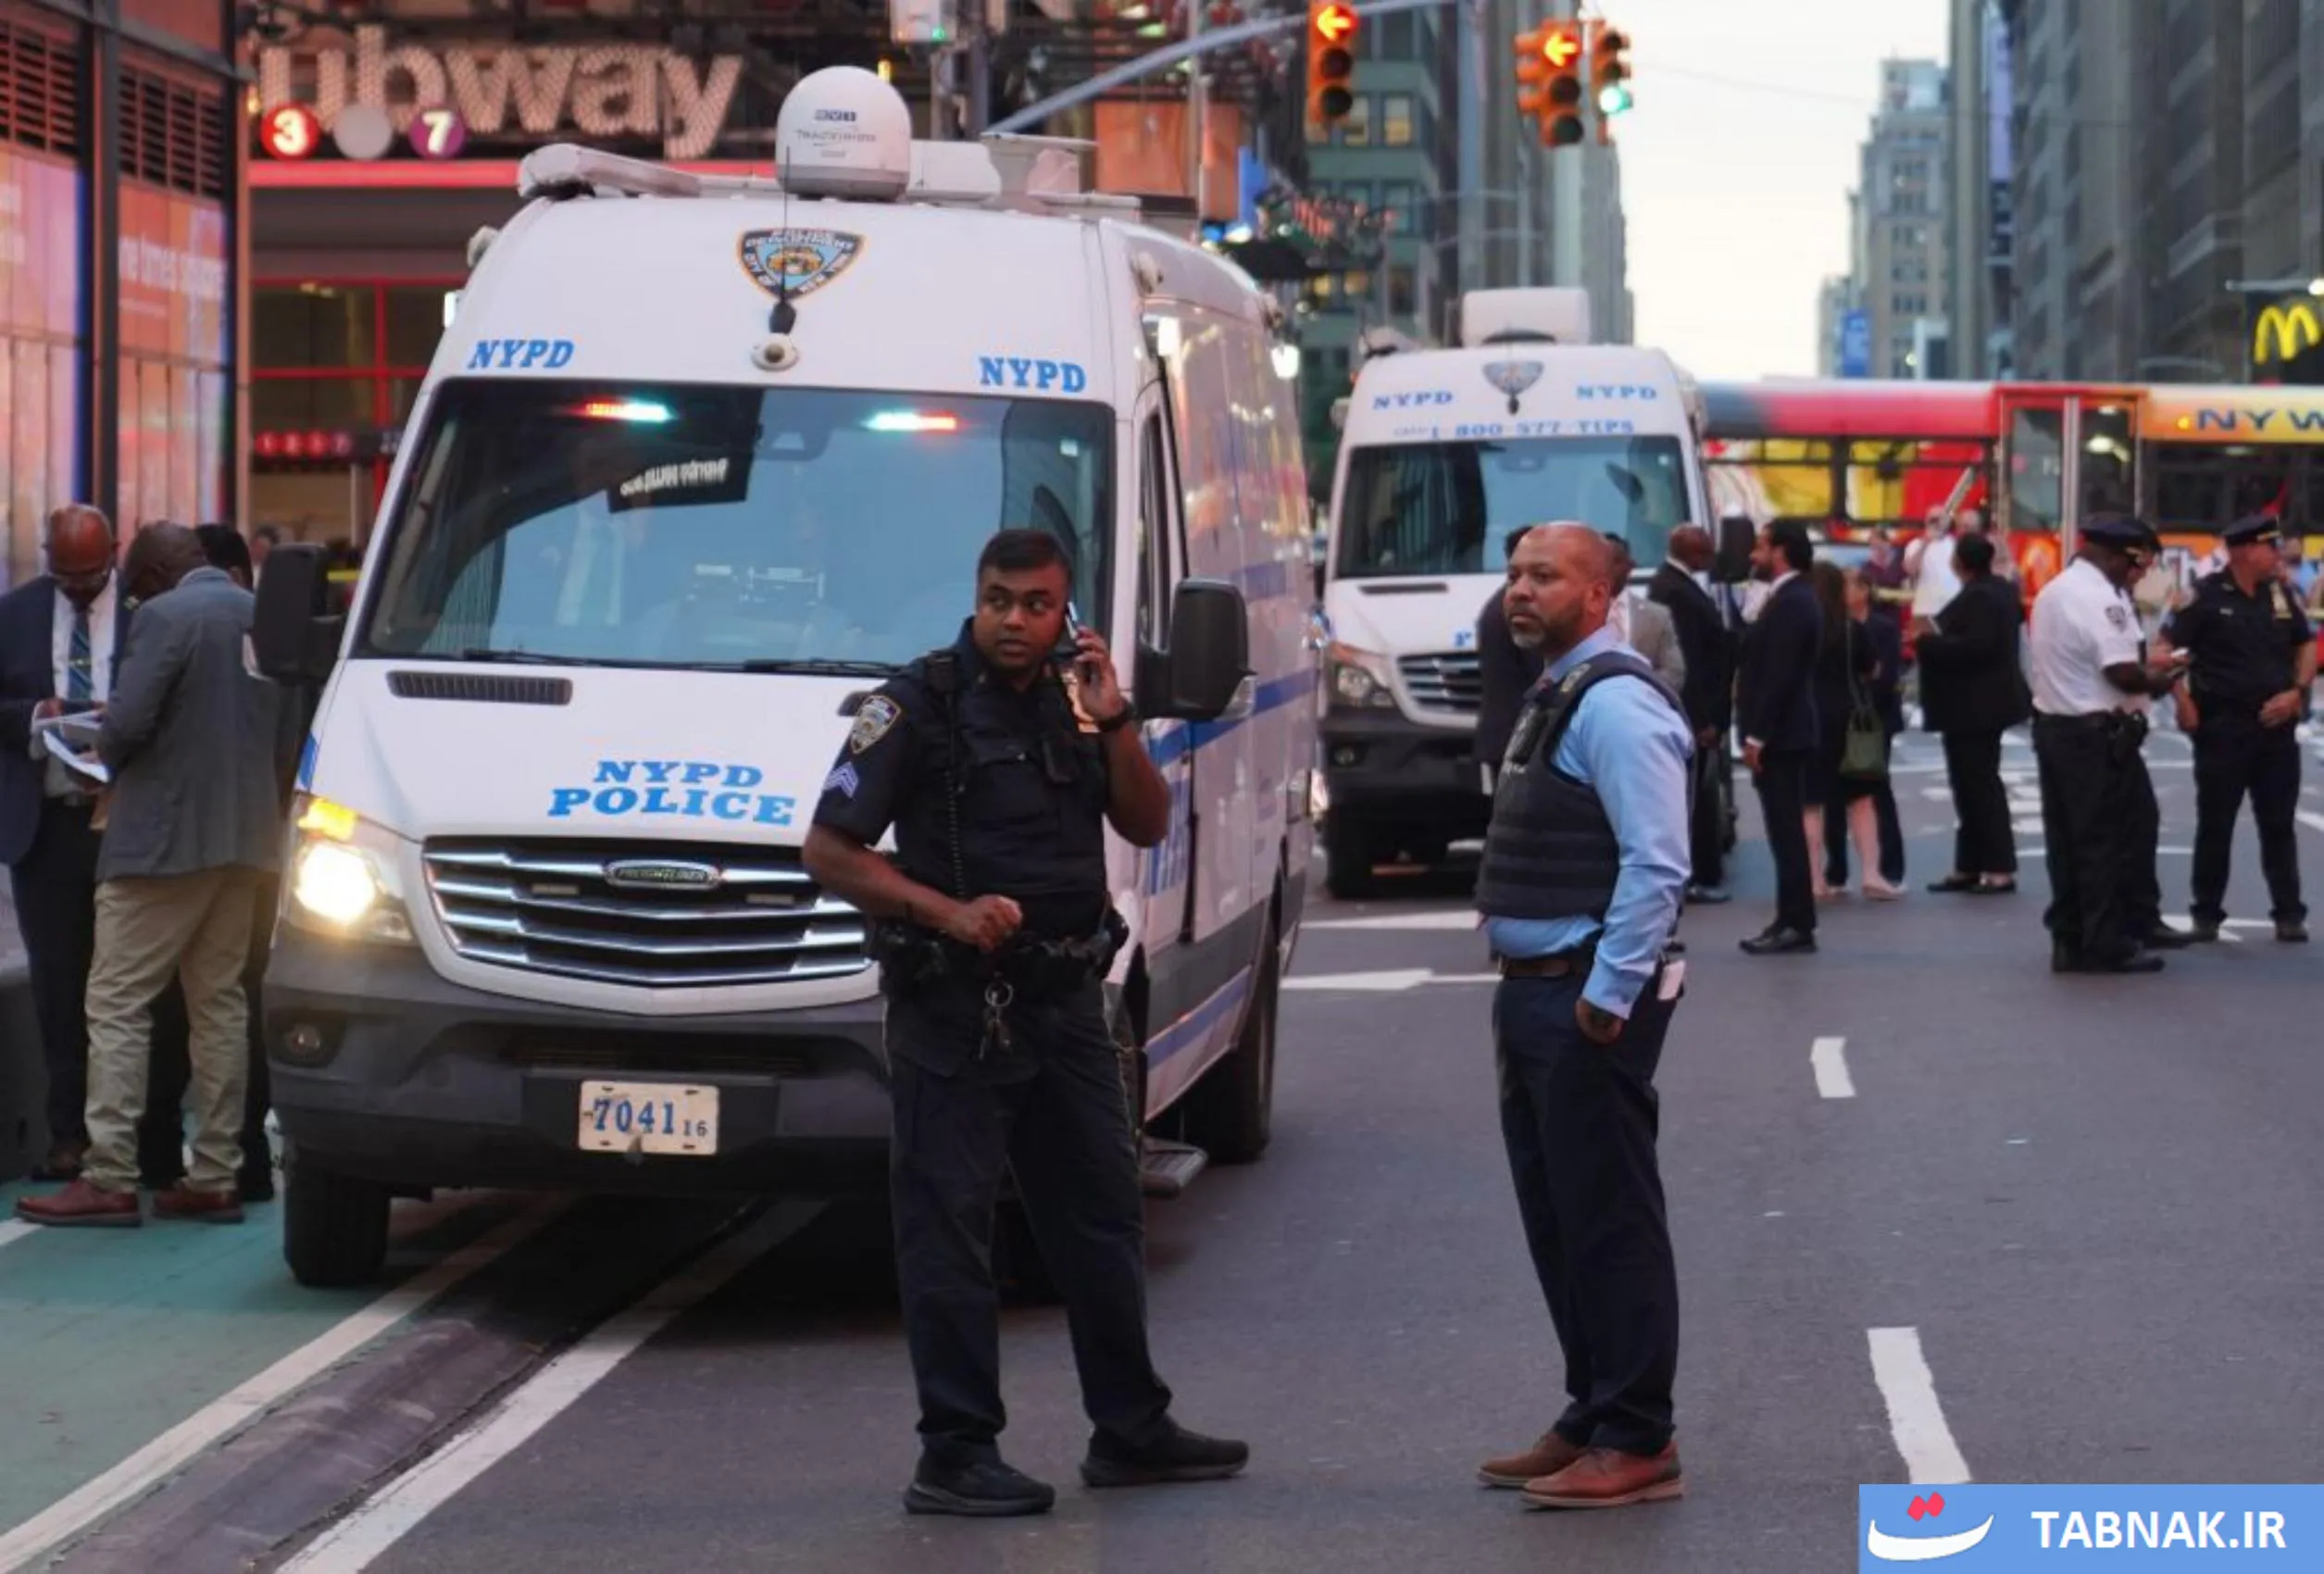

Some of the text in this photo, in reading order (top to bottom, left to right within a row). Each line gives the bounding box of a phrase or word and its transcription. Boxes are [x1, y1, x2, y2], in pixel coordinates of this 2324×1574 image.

[272, 109, 454, 155] 3 7
[467, 339, 575, 369] NYPD
[979, 356, 1086, 394] NYPD
[1373, 390, 1454, 409] NYPD
[1576, 385, 1656, 400] NYPD
[593, 760, 763, 787] NYPD
[547, 787, 796, 825] POLICE
[593, 1098, 707, 1137] 7041 16
